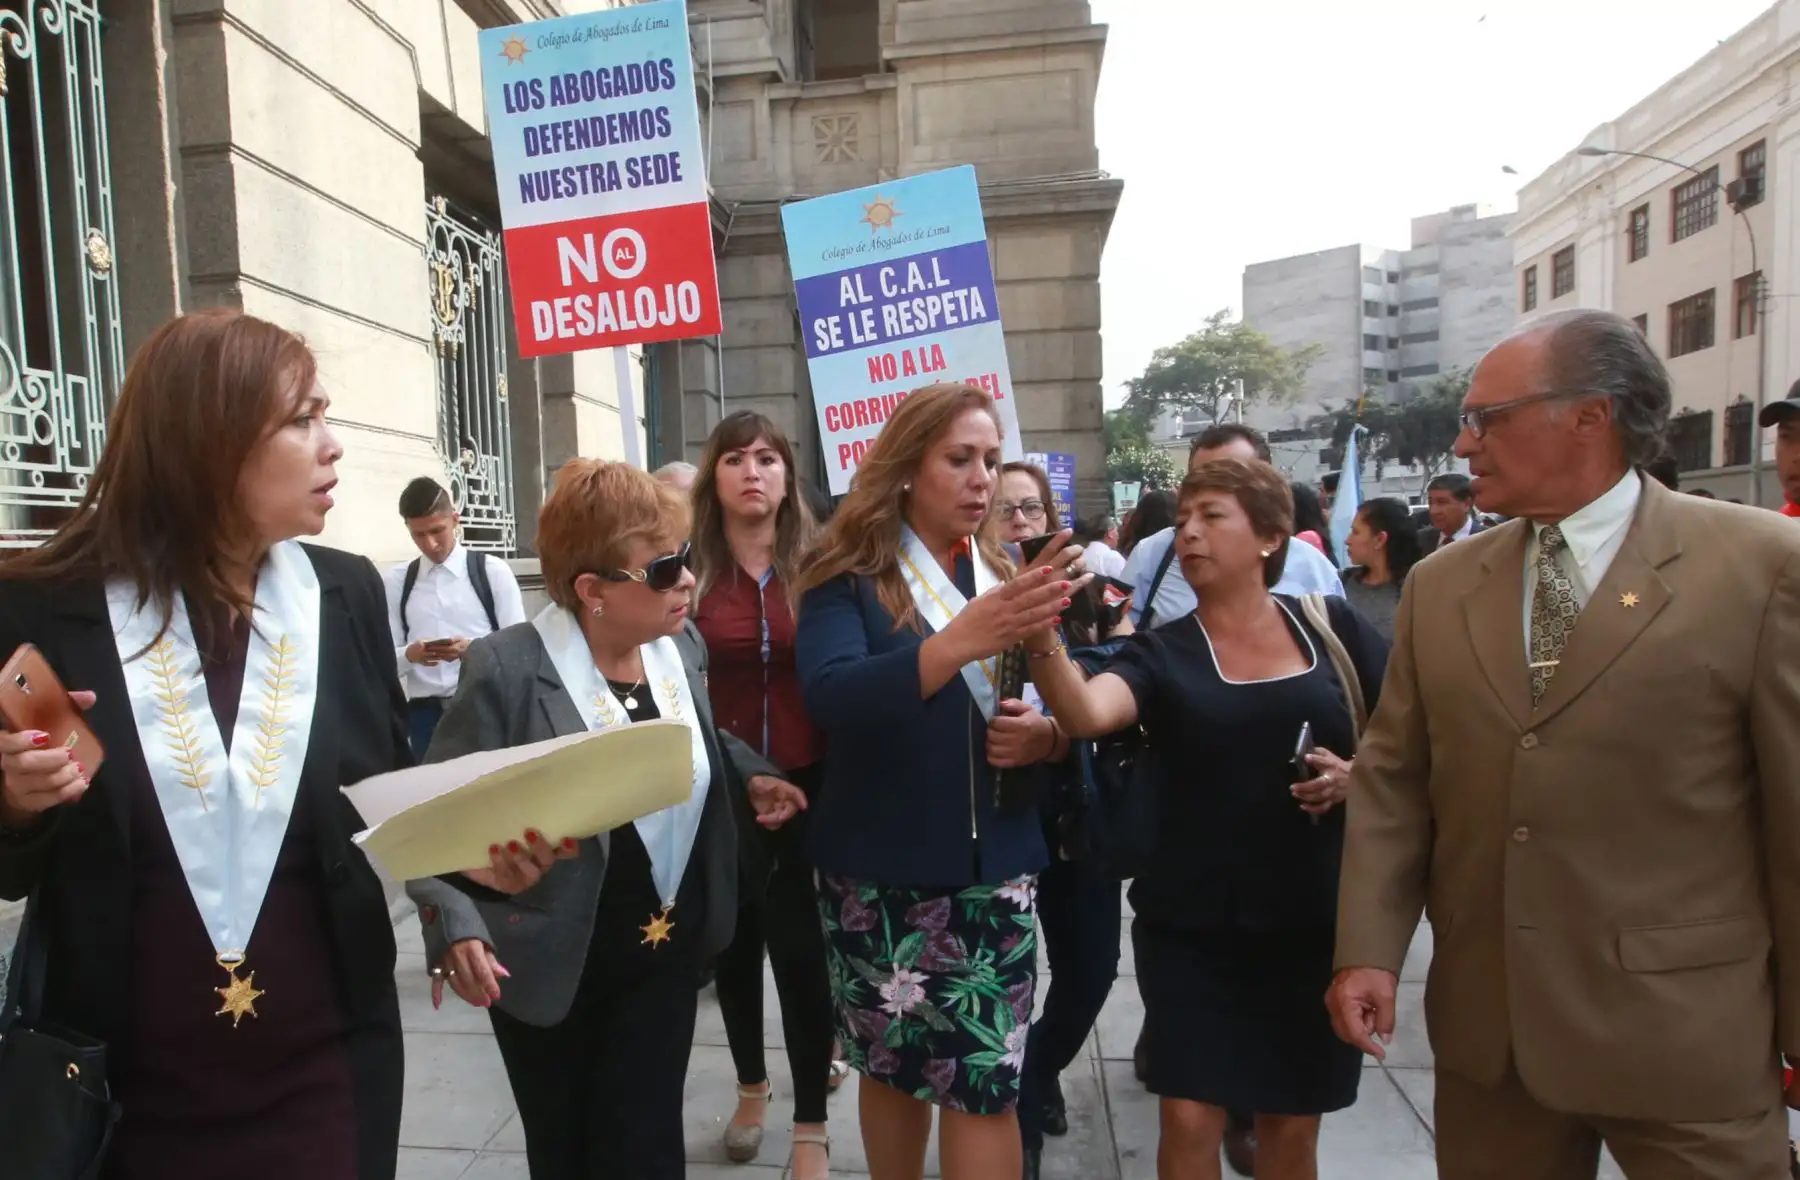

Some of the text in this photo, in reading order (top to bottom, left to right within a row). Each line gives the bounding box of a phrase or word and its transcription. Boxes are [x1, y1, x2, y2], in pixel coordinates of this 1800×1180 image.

[537, 17, 669, 49] Colegio de Abogados de Lima
[503, 57, 676, 114] LOS ABOGADOS
[523, 106, 672, 158] DEFENDEMOS
[519, 152, 683, 204] NUESTRA SEDE
[557, 228, 647, 286] NO
[615, 247, 635, 261] AL
[821, 225, 950, 262] Colegio de Abogados de Lima
[840, 257, 950, 307] AL C.A.L
[531, 280, 701, 341] DESALOJO
[814, 286, 987, 351] SE LE RESPETA
[867, 343, 946, 383] NO A LA
